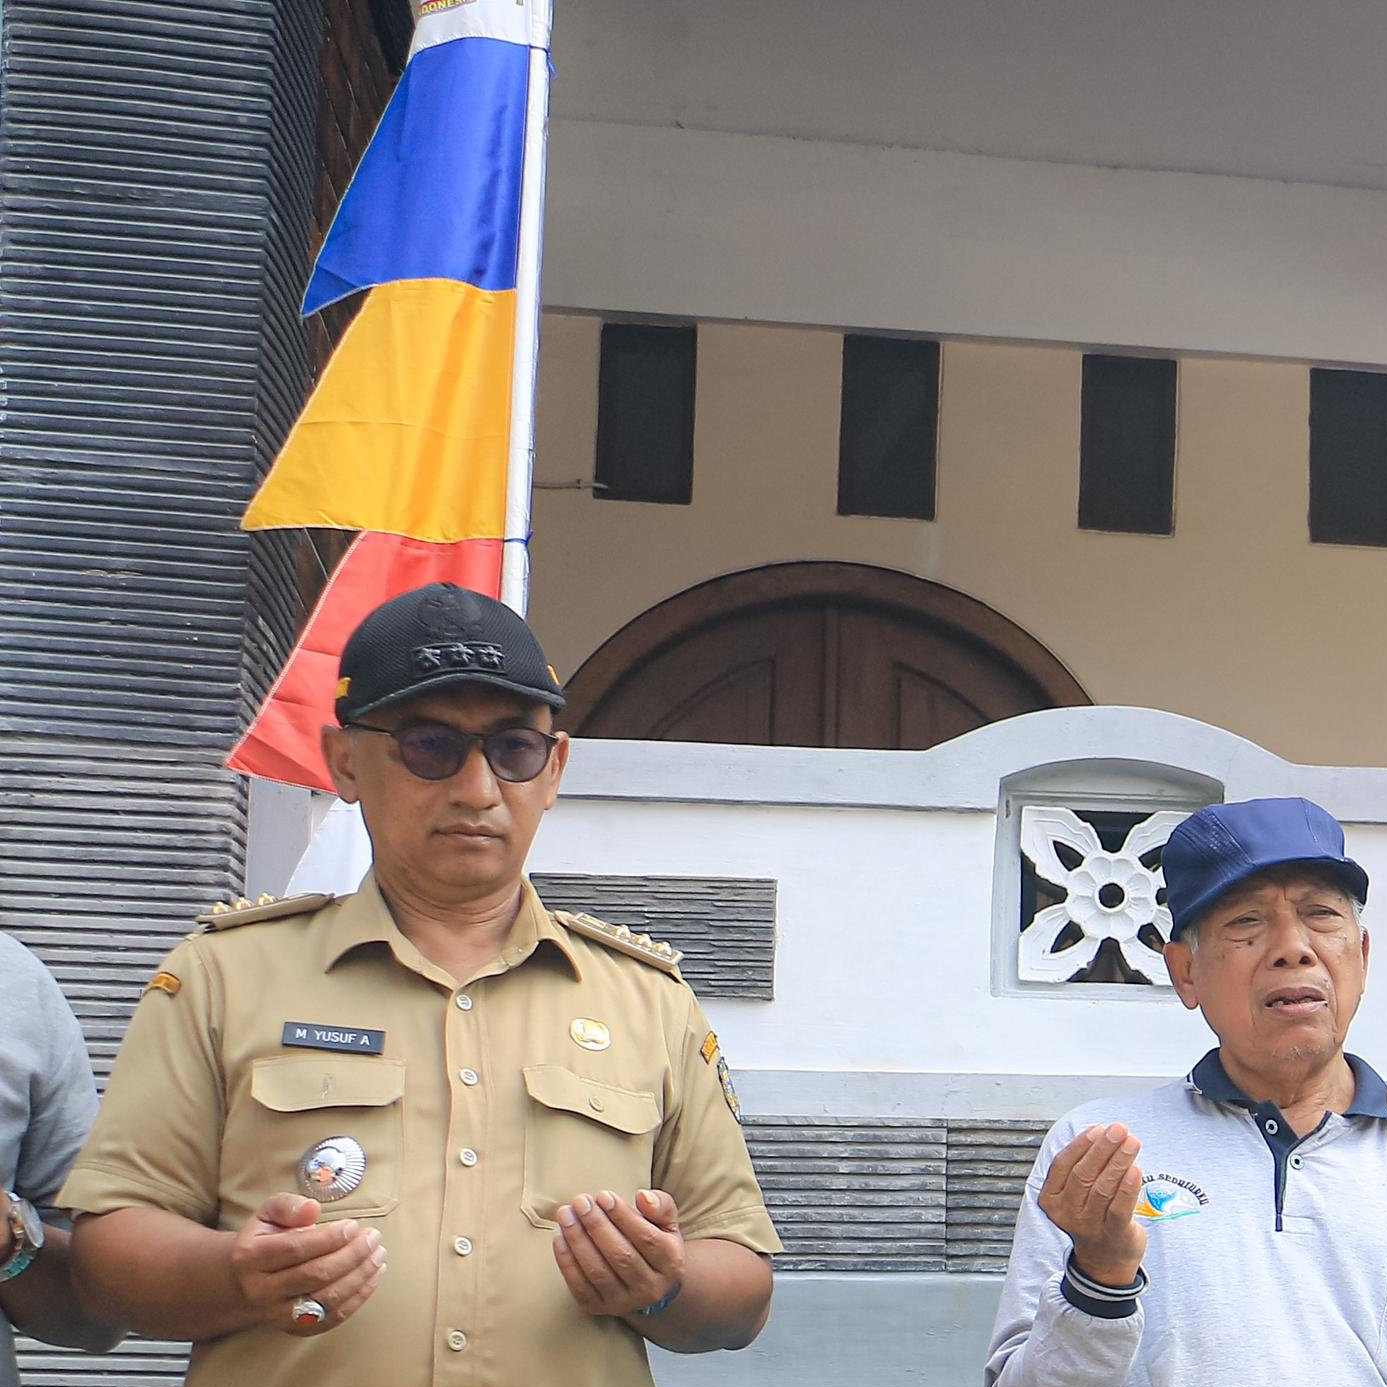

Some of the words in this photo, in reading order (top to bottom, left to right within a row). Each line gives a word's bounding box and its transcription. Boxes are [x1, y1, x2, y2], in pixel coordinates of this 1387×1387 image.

[295, 1028, 307, 1039] M
[314, 1030, 357, 1044] YUSUF
[360, 1035, 370, 1046] A
